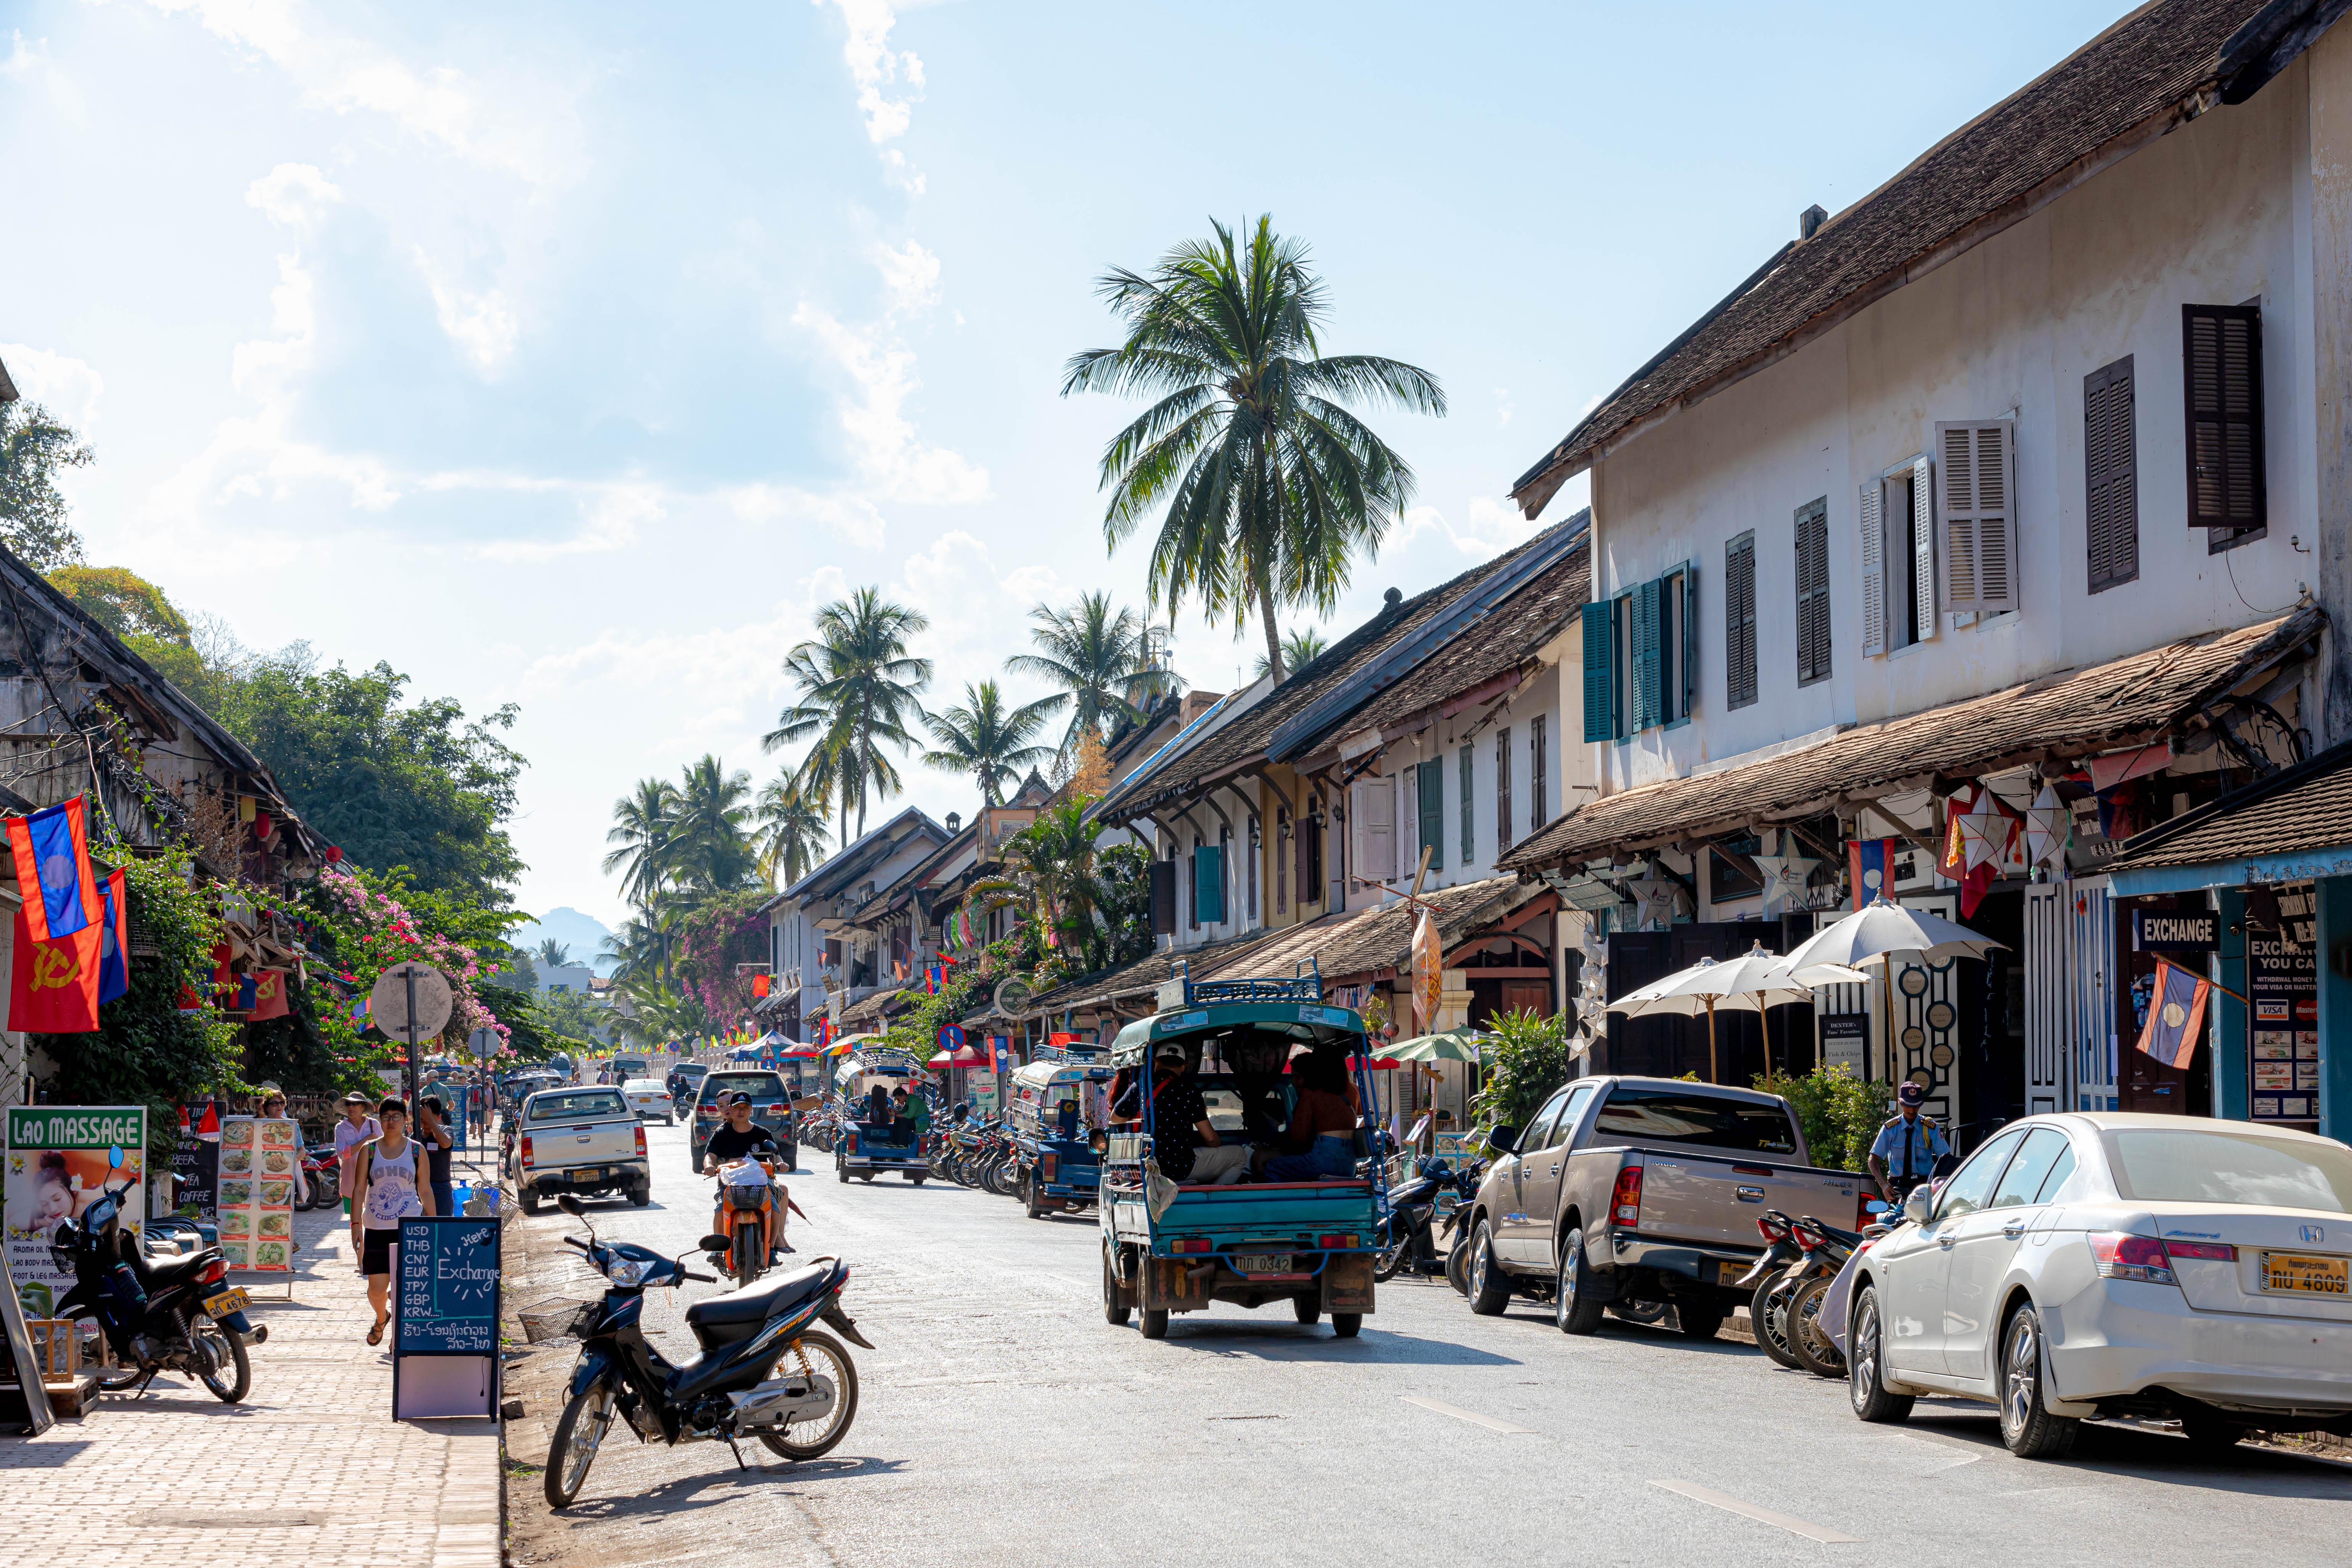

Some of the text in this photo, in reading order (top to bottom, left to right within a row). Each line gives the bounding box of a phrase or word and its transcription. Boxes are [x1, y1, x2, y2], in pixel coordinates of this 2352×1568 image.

[2145, 918, 2212, 942] EXCHANGE
[2260, 958, 2315, 969] YOU CA
[388, 1076, 399, 1084] Spa
[14, 1117, 138, 1144] LAO MASSAGE
[172, 1154, 199, 1165] BEER
[1651, 1160, 1677, 1168] TOYOTA
[185, 1173, 199, 1186] TEA
[179, 1190, 211, 1202] COFFEE
[406, 1226, 429, 1235] USD
[2164, 1229, 2221, 1239] Accord
[461, 1227, 489, 1246] Here
[406, 1240, 430, 1251] THB
[405, 1254, 429, 1264] CNY
[1260, 1258, 1289, 1272] 0342
[405, 1267, 429, 1277] EUR
[438, 1259, 500, 1291] Exchange
[405, 1281, 428, 1291] JPY
[2302, 1272, 2345, 1293] 4809
[227, 1296, 249, 1310] 4678
[405, 1294, 430, 1306] GBP
